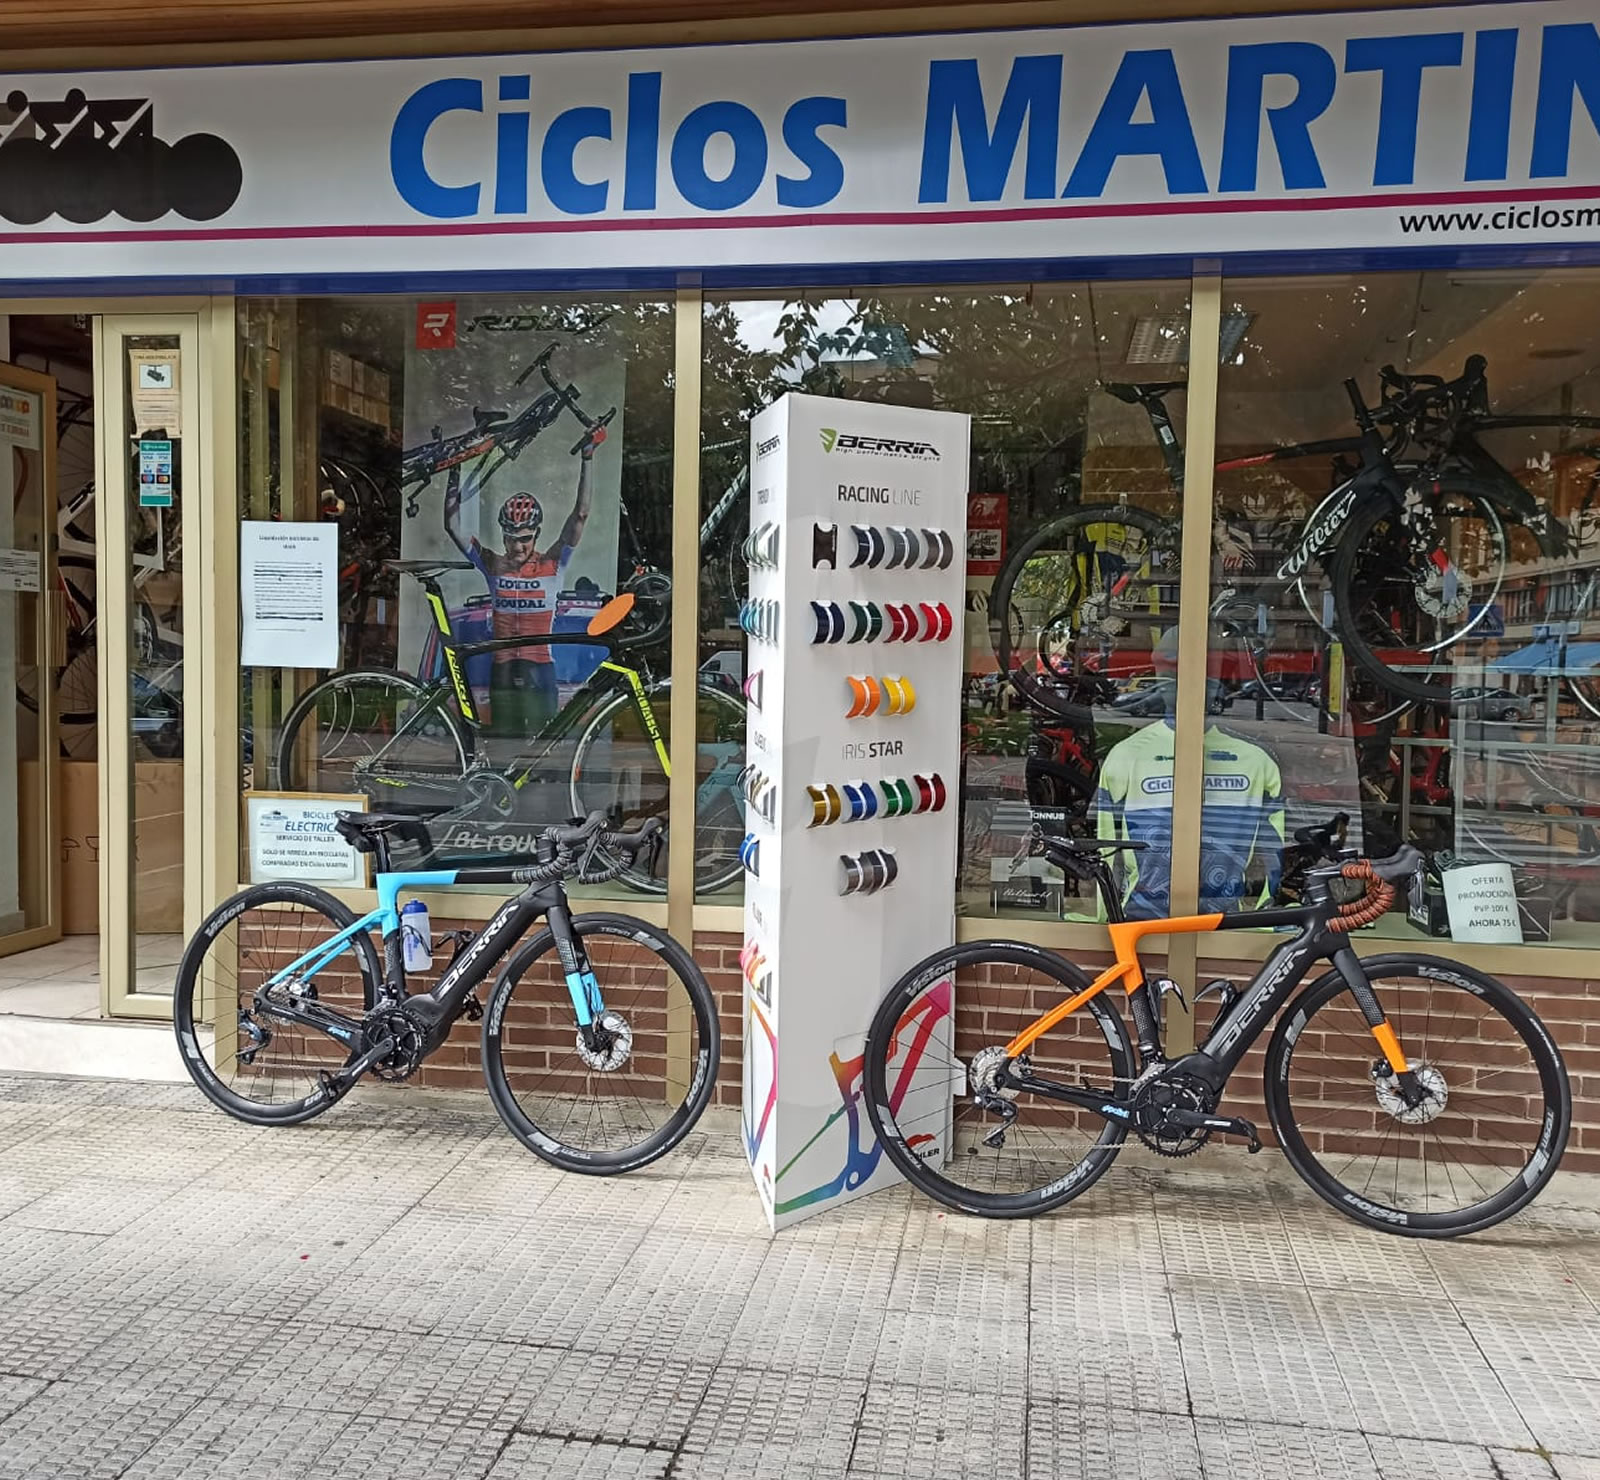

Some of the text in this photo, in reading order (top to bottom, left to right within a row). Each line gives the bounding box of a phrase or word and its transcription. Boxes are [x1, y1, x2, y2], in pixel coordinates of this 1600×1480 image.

[391, 72, 847, 219] Ciclos
[837, 434, 941, 456] BERRIA
[837, 484, 921, 506] RACING LINE
[1277, 493, 1357, 580] Wilier
[499, 580, 541, 590] LOTTO
[496, 600, 546, 609] SOUDAL
[842, 740, 903, 760] IRIS STAR
[1147, 776, 1244, 791] Cicl ARTIN
[303, 811, 336, 821] BICICLET
[285, 821, 338, 834] ELECTRIC
[1472, 876, 1504, 885] OFERTA
[1469, 919, 1500, 928] AHORA
[1418, 965, 1486, 995] Vision
